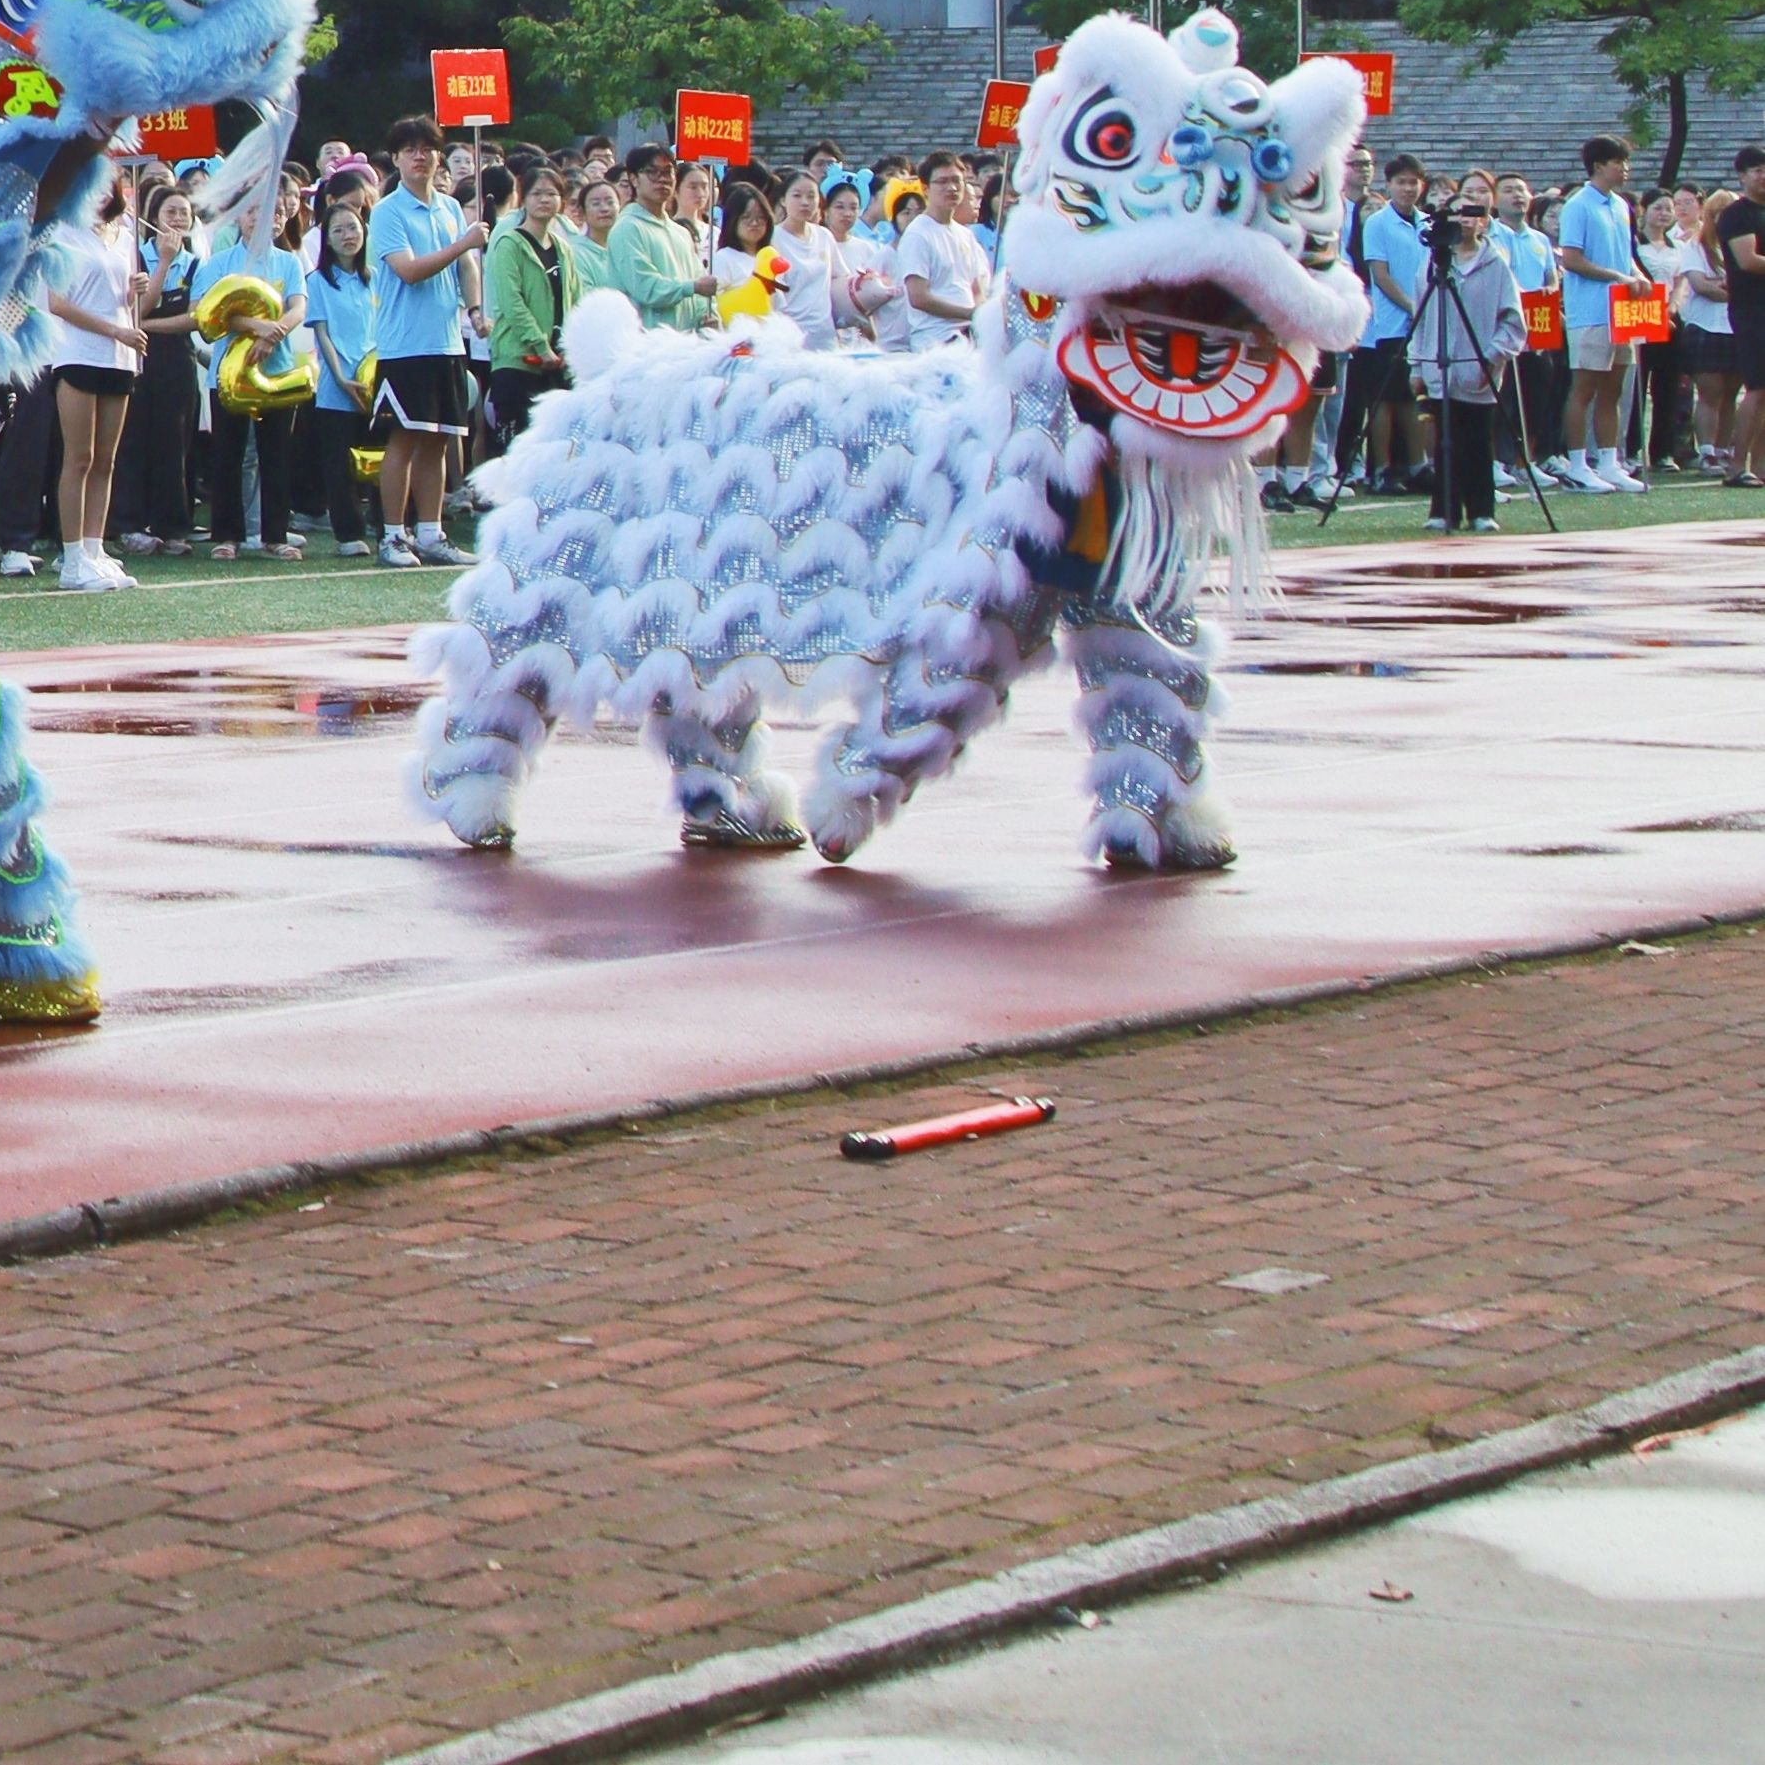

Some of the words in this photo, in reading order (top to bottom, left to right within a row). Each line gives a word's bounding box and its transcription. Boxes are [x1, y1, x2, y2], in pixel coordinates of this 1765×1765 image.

[446, 74, 497, 98] 动医232班
[684, 114, 744, 143] 动科222班
